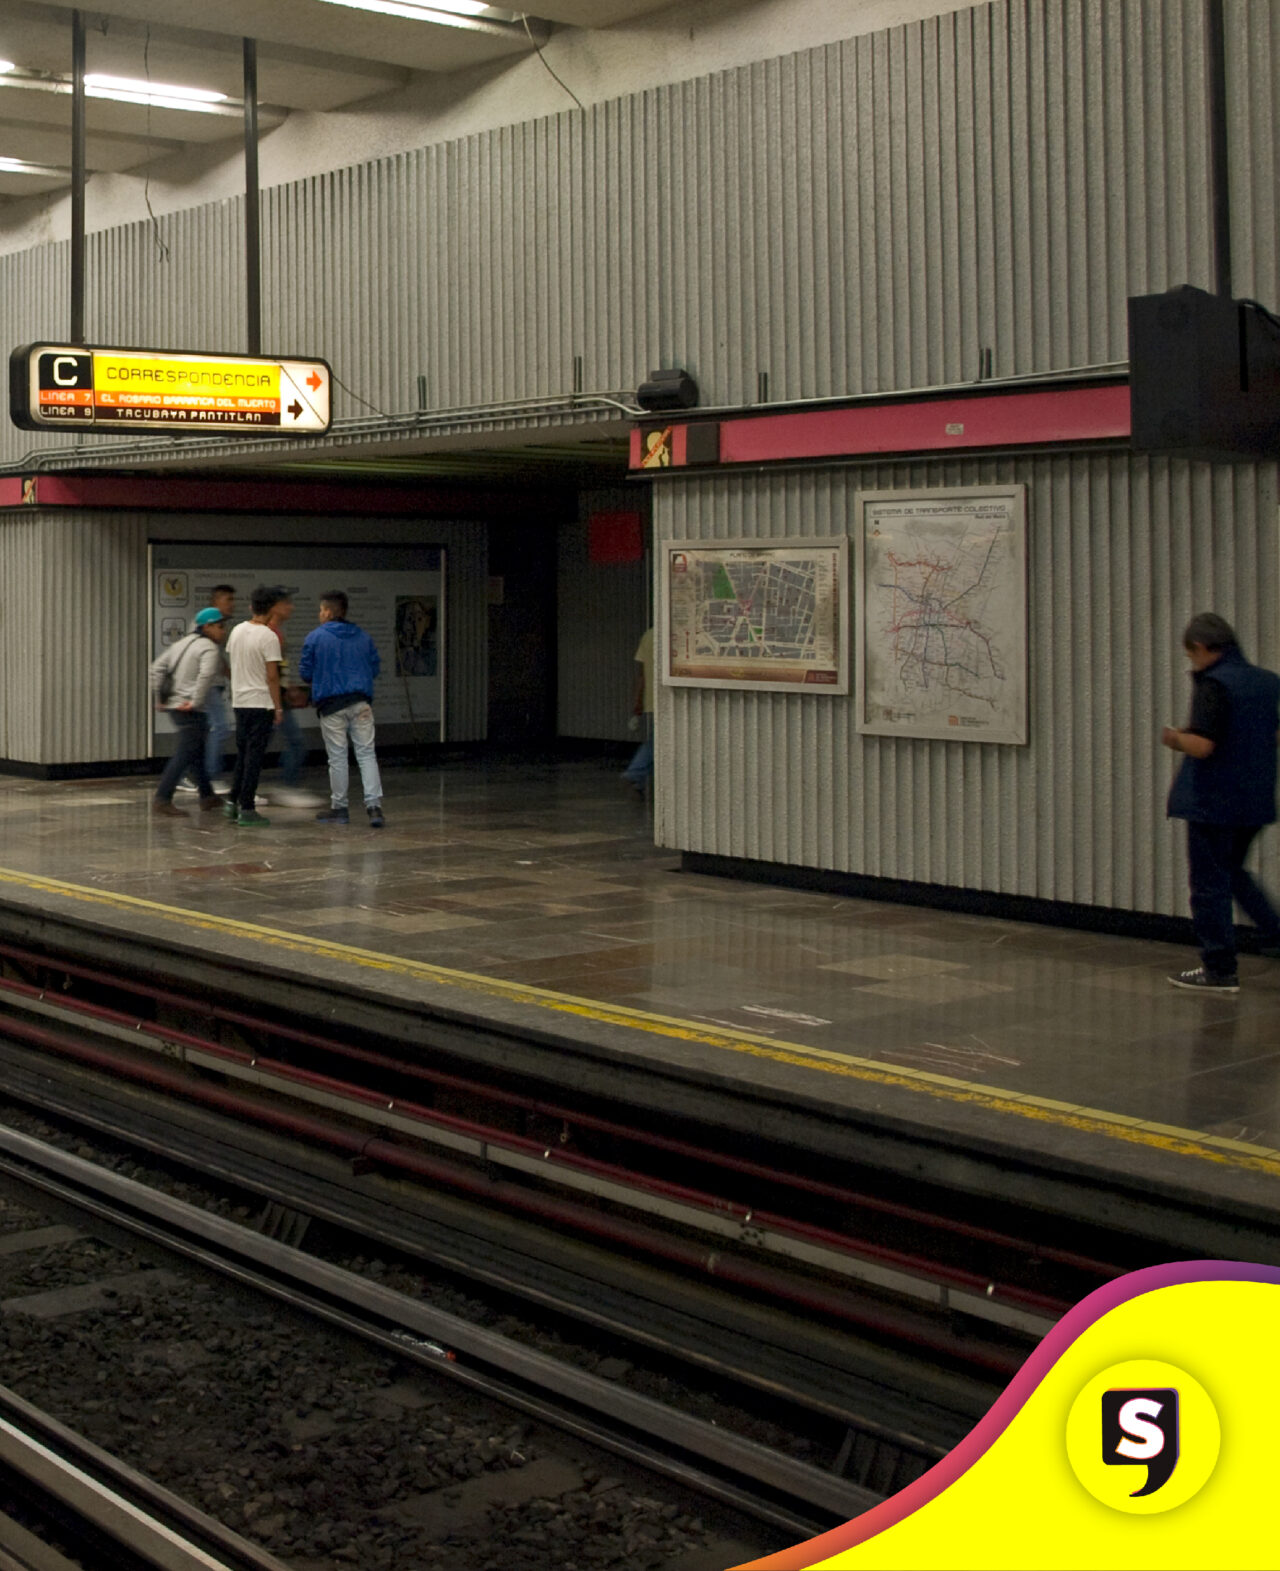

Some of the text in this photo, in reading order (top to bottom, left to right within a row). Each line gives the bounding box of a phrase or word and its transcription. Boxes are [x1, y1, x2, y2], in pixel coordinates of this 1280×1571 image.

[53, 357, 78, 386] C
[106, 367, 271, 387] CORRESPONDENCIA
[41, 392, 91, 402] LINEA 7
[101, 393, 276, 409] EL ROSARIO BARRANCA DEL MUERTO
[41, 406, 75, 416] LINEA
[116, 408, 261, 422] TACUBAYA PANTITLAN
[916, 505, 962, 514] TRANSPORTE
[964, 504, 1006, 513] COLECTIVO
